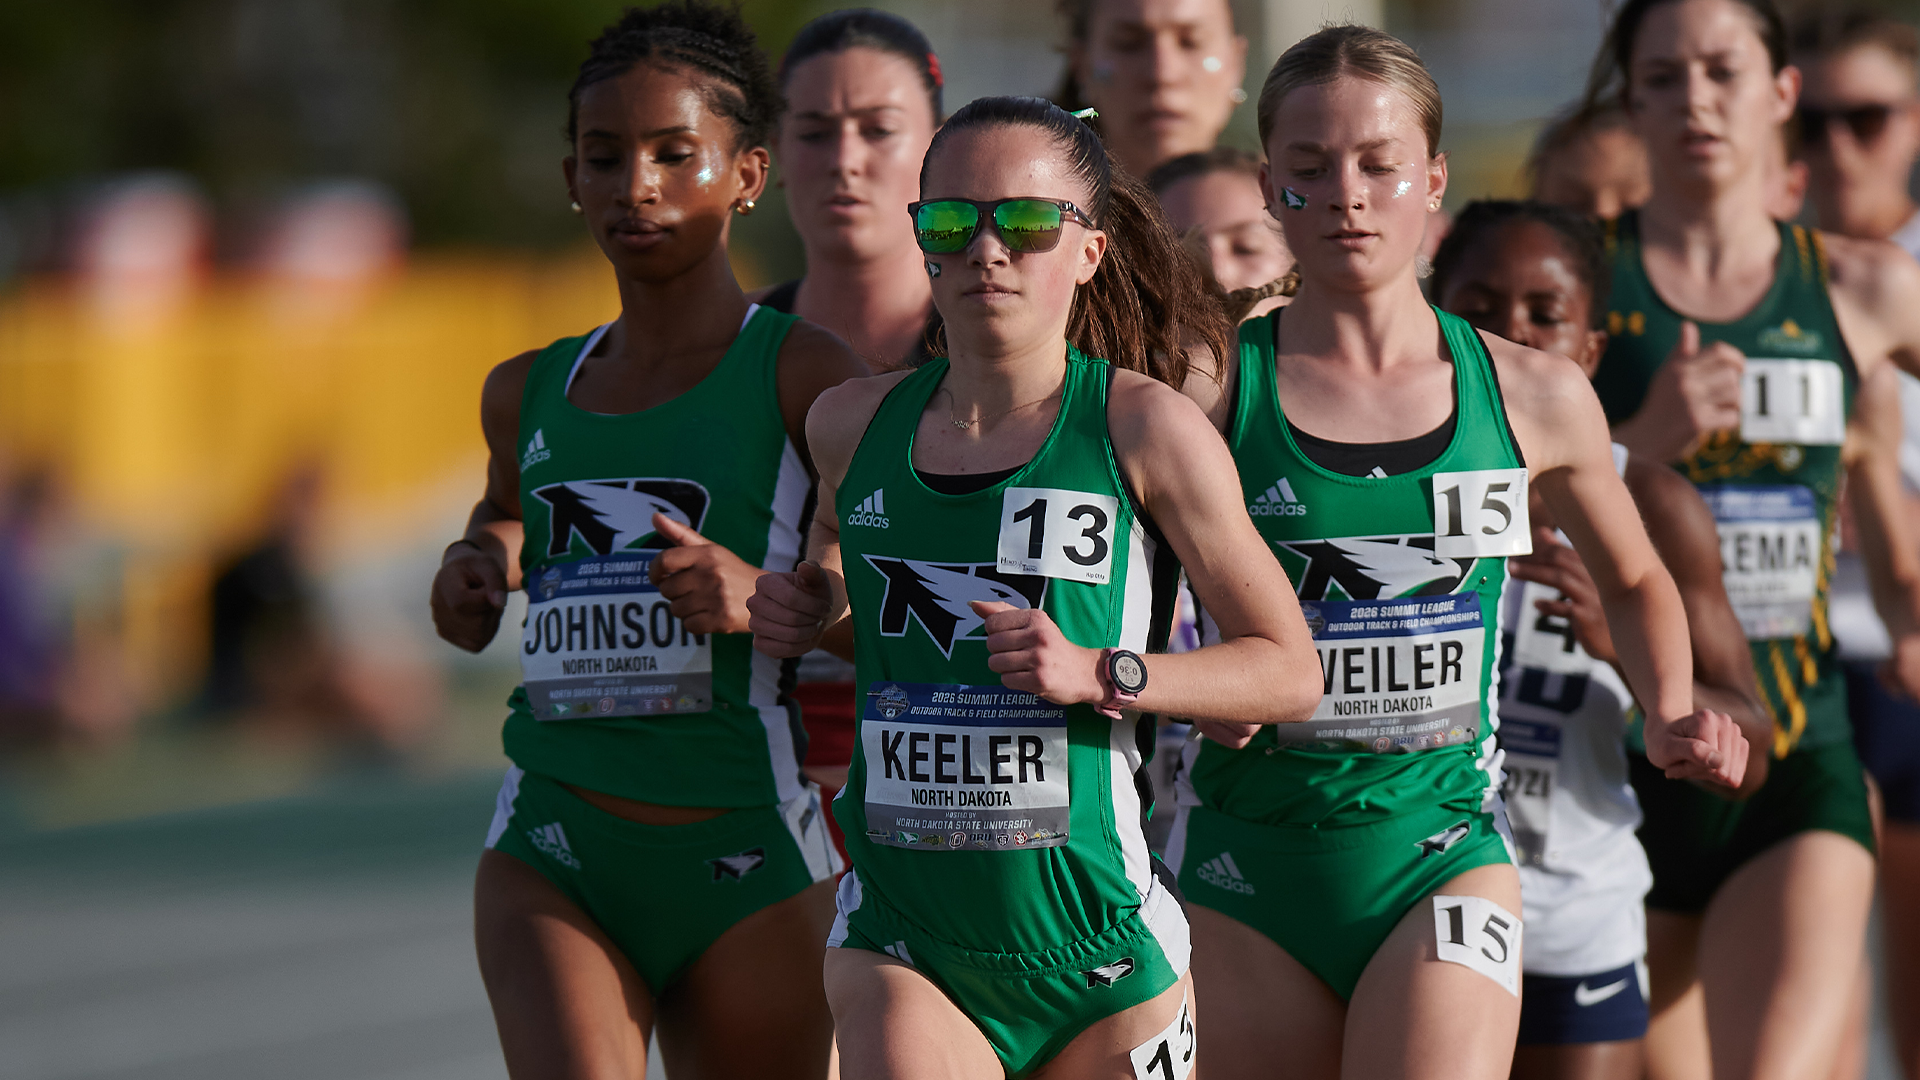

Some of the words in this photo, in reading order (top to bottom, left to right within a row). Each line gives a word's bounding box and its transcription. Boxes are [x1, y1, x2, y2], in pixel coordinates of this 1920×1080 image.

[1249, 501, 1307, 516] adidas
[1436, 482, 1512, 537] 15
[848, 511, 890, 529] adidas
[1013, 498, 1108, 566] 13
[1721, 534, 1812, 572] EMA
[602, 560, 643, 573] SUMMIT
[590, 577, 612, 586] TRACK
[621, 576, 641, 585] FIELD
[1350, 606, 1378, 619] 2026
[1380, 603, 1420, 617] SUMMIT
[1421, 600, 1456, 614] LEAGUE
[1328, 621, 1364, 632] OUTDOOR
[1366, 620, 1391, 630] TRACK
[1399, 618, 1419, 629] FIELD
[1419, 611, 1480, 627] CHAMPIONSHIPS
[562, 658, 601, 675] NORTH
[606, 655, 658, 673] DAKOTA
[604, 686, 628, 696] STATE
[932, 691, 955, 703] 2026
[957, 693, 999, 705] SUMMIT
[1000, 694, 1039, 705] LEAGUE
[911, 706, 942, 716] OUTDOOR
[944, 708, 966, 718] TRACK
[969, 709, 974, 717] &
[976, 709, 997, 718] FIELD
[998, 709, 1064, 719] CHAMPIONSHIPS
[1334, 699, 1378, 716] NORTH
[1383, 695, 1433, 713] DAKOTA
[1315, 729, 1344, 738] NORTH
[1345, 727, 1378, 738] DAKOTA
[1380, 725, 1405, 736] STATE
[1406, 718, 1450, 734] UNIVERSITY
[881, 729, 1045, 784] KEELER
[911, 788, 953, 806] NORTH
[958, 790, 1012, 807] DAKOTA
[896, 817, 920, 828] NORTH
[922, 819, 953, 830] DAKOTA
[955, 821, 981, 831] STATE
[983, 818, 1033, 830] UNIVERSITY
[1197, 867, 1255, 895] adidas
[1437, 904, 1508, 963] 15
